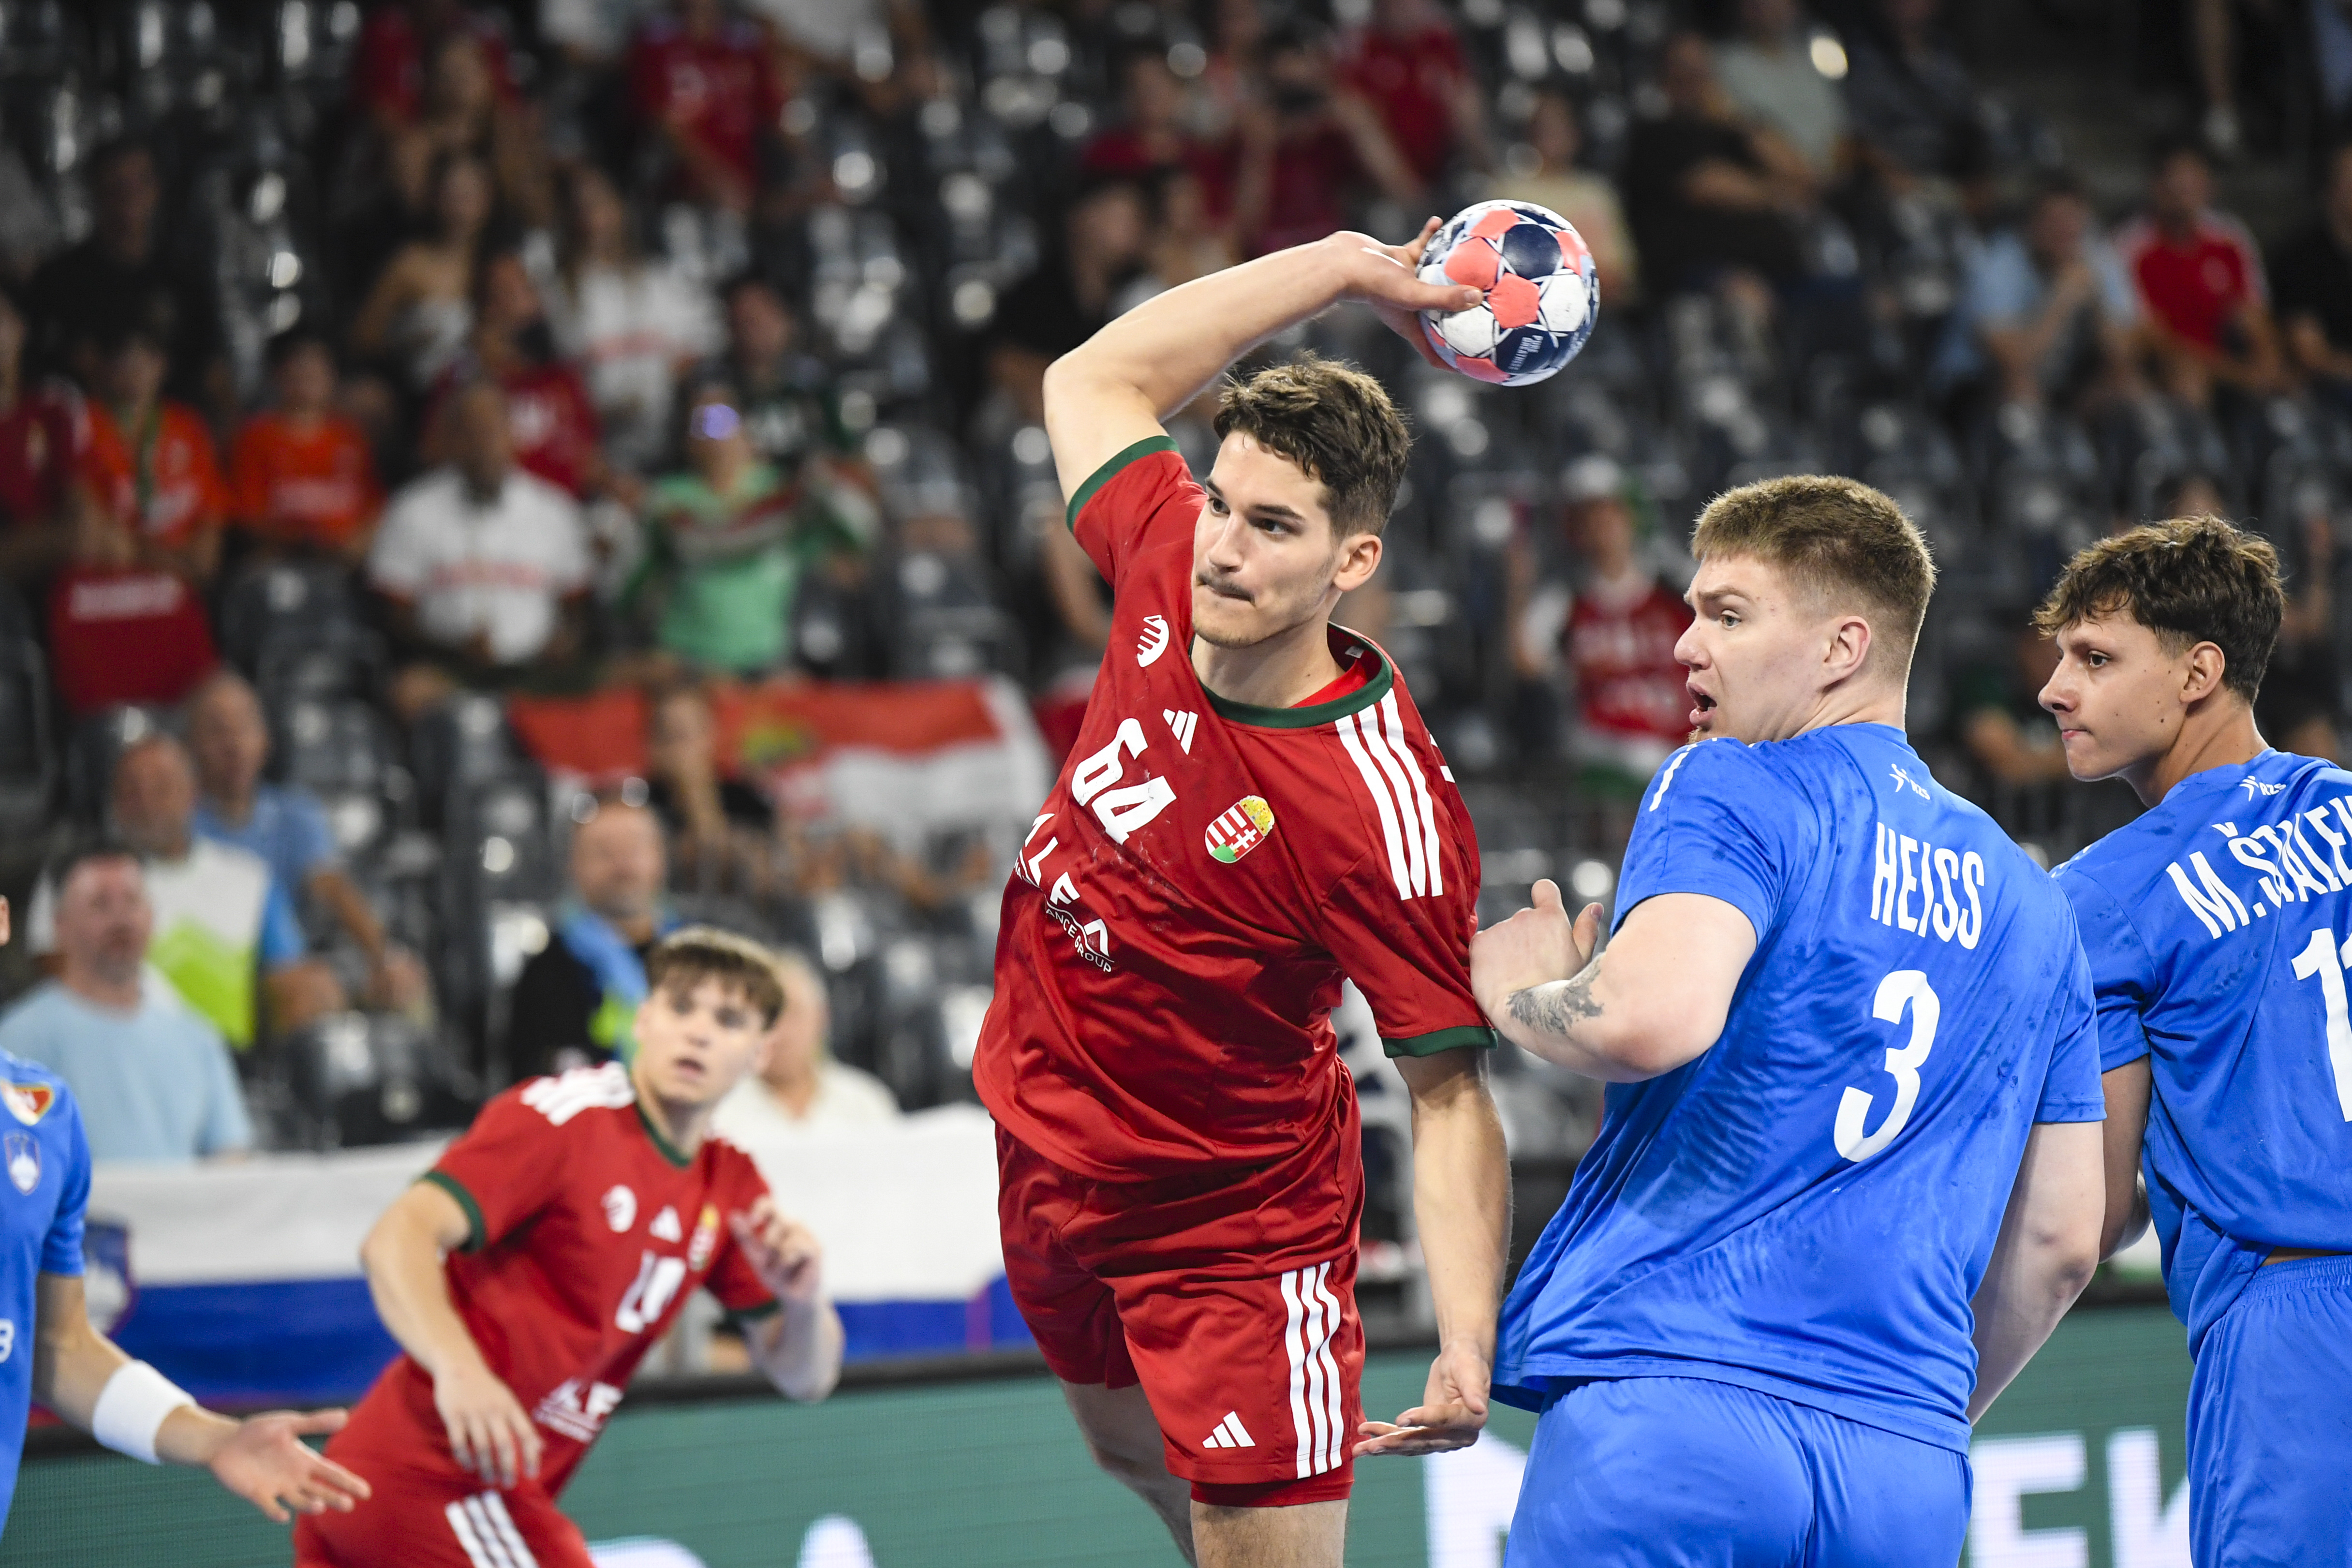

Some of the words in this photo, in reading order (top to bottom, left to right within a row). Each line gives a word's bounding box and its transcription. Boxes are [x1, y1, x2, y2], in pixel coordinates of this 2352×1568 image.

[1071, 718, 1177, 845] 64
[2259, 782, 2287, 796] RZS
[1869, 821, 1985, 950] HEISS
[1074, 934, 1112, 973] GROUP
[1833, 969, 1940, 1163] 3
[2291, 927, 2352, 1123] 1
